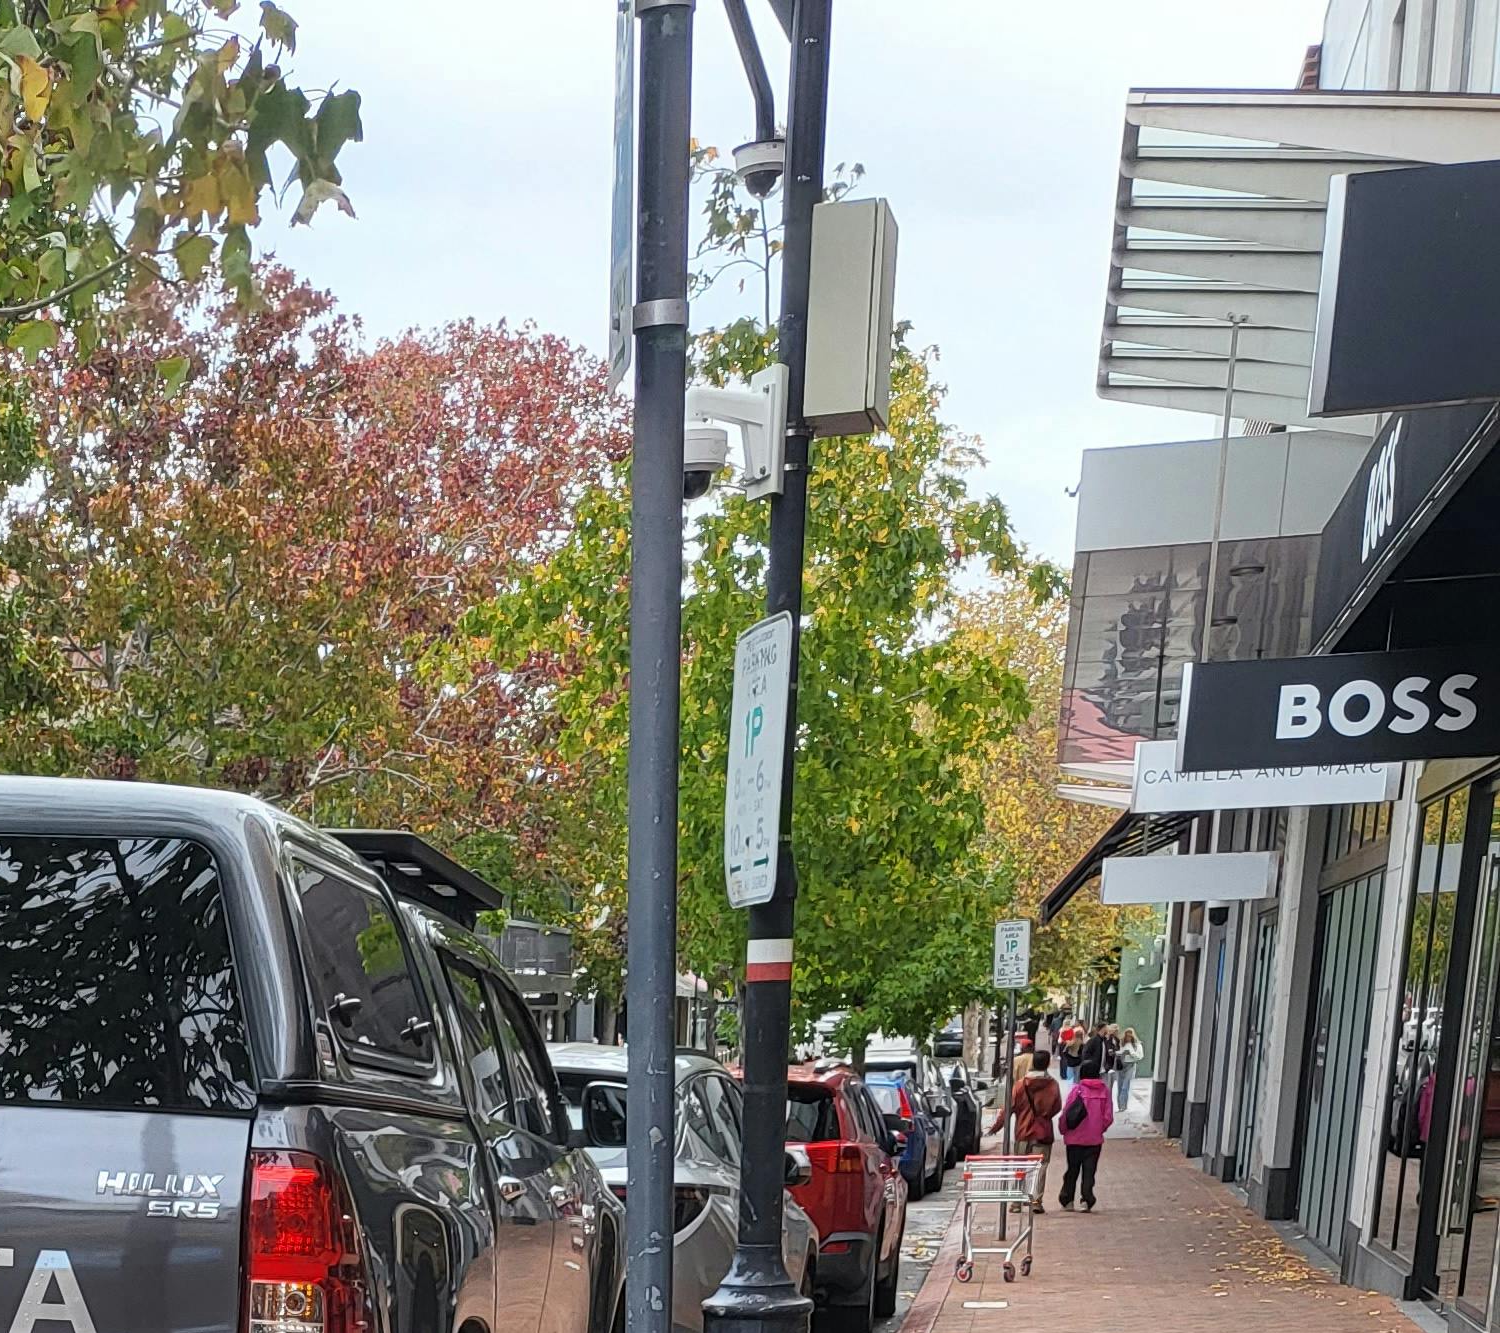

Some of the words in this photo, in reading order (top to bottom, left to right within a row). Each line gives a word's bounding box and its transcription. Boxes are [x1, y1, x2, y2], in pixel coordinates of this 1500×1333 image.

[1276, 674, 1479, 740] BOSS
[745, 706, 763, 758] 1P
[1143, 768, 1243, 785] CAMILLA
[1255, 766, 1303, 779] AND
[1317, 763, 1383, 776] MARC
[1005, 940, 1018, 953] 1P
[96, 1170, 225, 1198] HILUX
[146, 1200, 220, 1219] SR5
